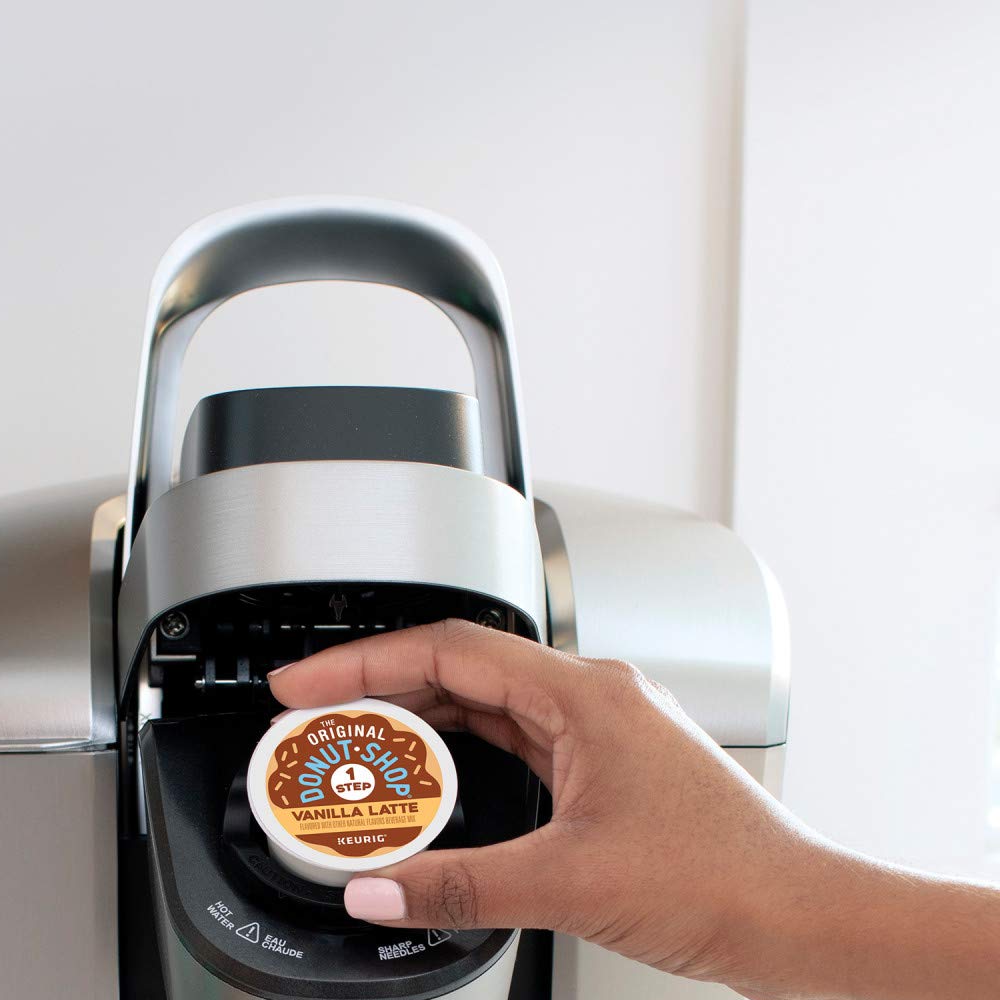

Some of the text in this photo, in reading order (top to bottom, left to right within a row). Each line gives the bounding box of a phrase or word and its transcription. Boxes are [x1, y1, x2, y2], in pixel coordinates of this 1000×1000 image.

[320, 719, 335, 728] THE
[307, 724, 386, 746] ORIGINAL
[298, 739, 411, 804] DONUT SHOP
[345, 767, 355, 780] 1
[335, 782, 372, 793] STEP
[291, 802, 419, 822] VANILLA LATTE
[337, 834, 385, 845] KEURIG
[206, 904, 235, 931] WATER
[215, 900, 234, 918] HOT
[264, 934, 287, 947] EAU
[378, 940, 413, 954] SHARP
[261, 941, 304, 959] CHAUDE
[379, 943, 426, 961] NEEDLES
